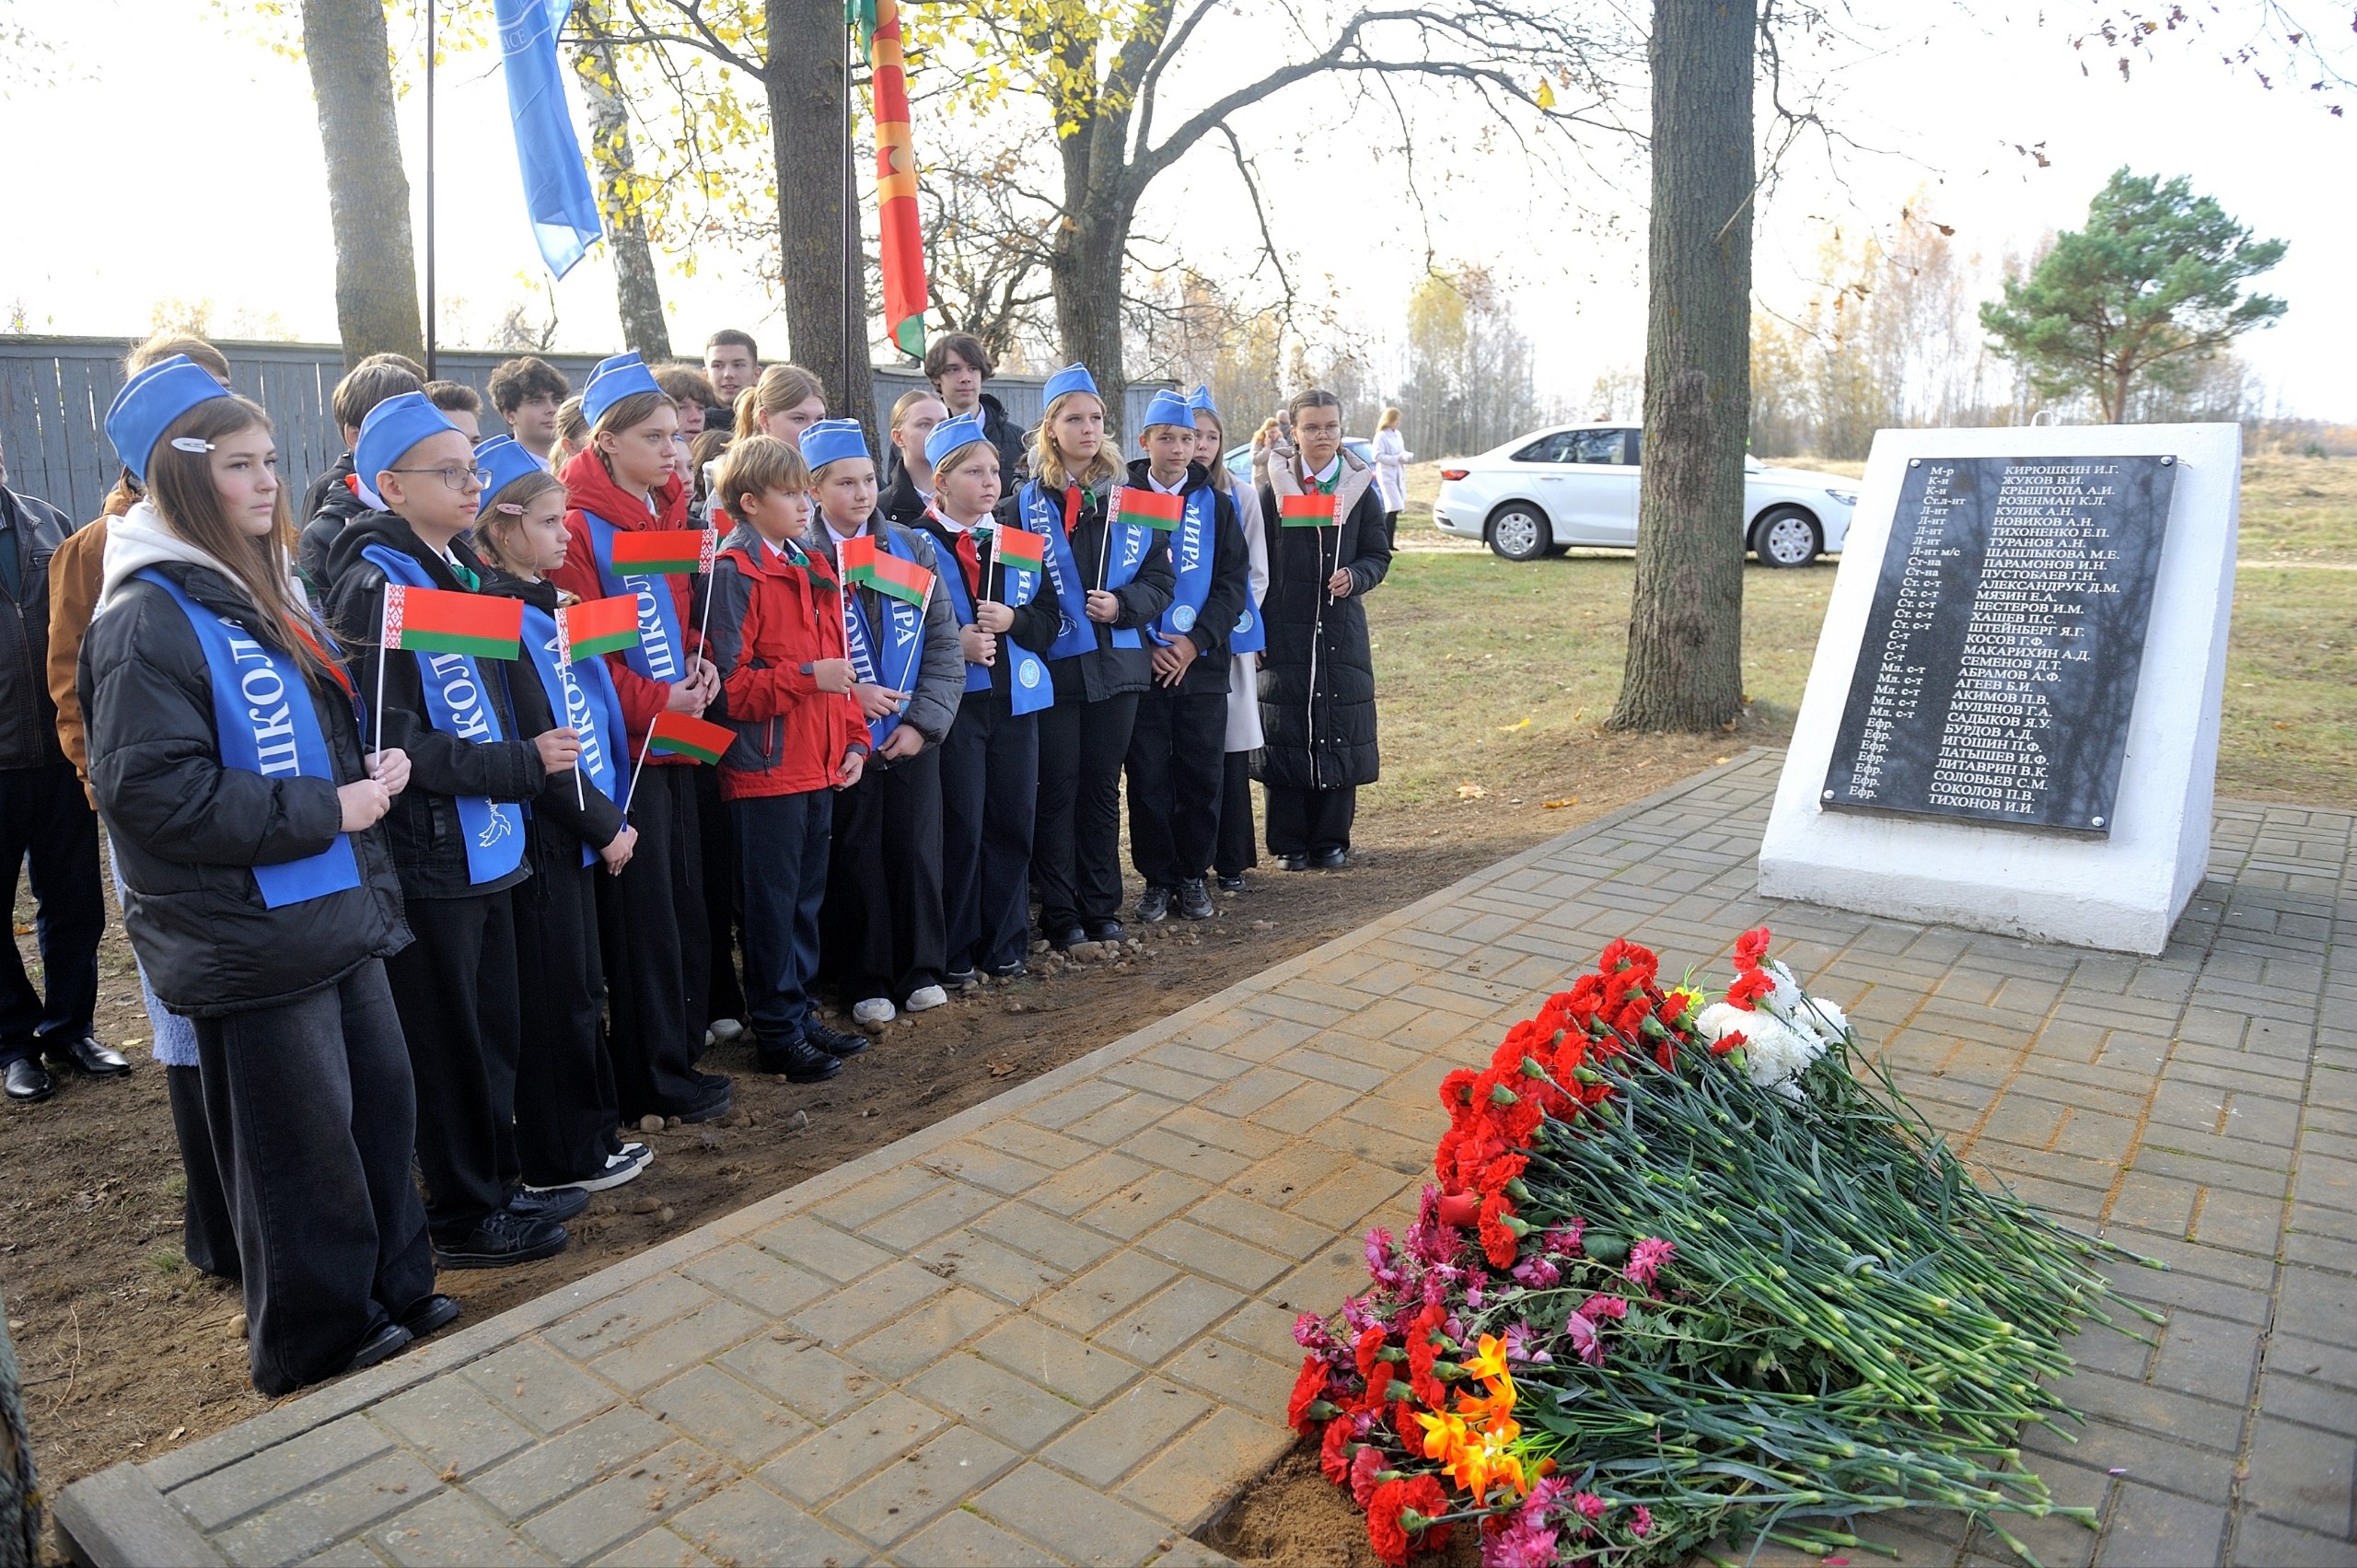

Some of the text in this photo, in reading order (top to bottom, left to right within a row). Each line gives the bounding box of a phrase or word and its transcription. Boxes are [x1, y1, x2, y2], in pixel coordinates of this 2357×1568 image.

[1930, 466, 2119, 477] М-р КИРЮШКИН И.Г.
[2003, 477, 2052, 485] ЖУКОВ
[2057, 477, 2084, 485] В.И.
[1926, 486, 2115, 495] К-н КРЫШТОПА А.И.
[1998, 497, 2075, 505] РОЗЕНМАН
[2079, 497, 2106, 505] К.Л.
[1920, 506, 2073, 516] Л-нт КУЛИК А.Н.
[1918, 517, 2095, 527] Л-нт НОВИКОВ А.Н.
[1180, 503, 1201, 574] МИРА
[1915, 527, 2109, 538] Л-нт ТИХОНЕНКО Е.П.
[1122, 524, 1143, 567] ИРА
[1912, 537, 2085, 548] Л-нт ТУРАНОВ А.Н.
[1910, 547, 2119, 559] Л-нт м/с ШАШЛЫКОВА М.Е.
[1908, 557, 2107, 570] Ст-на ПАРАМОНОВ И.Н.
[1905, 567, 2096, 581] Ст-на ПУСТОБАЕВ Г.Н.
[1014, 570, 1031, 608] ИР
[1903, 577, 1920, 587] Ст.
[1979, 580, 2085, 592] АЛЕКСАНДРУК
[2088, 584, 2119, 593] Д.М.
[1900, 588, 1917, 597] Ст.
[1976, 590, 2026, 600] МЯЗИН
[2029, 593, 2057, 602] Е.А.
[1898, 598, 1914, 607] Ст.
[1973, 601, 2049, 612] НЕСТЕРОВ
[2052, 604, 2084, 614] И.М.
[1895, 609, 1911, 618] Ст.
[2028, 614, 2056, 624] П.С.
[623, 575, 676, 680] ШКОЛ
[1892, 620, 1909, 629] Ст.
[1968, 622, 2057, 635] ШТЕЙНБЕРГ
[2060, 627, 2084, 636] Я.Г.
[844, 591, 877, 684] ШКО
[1889, 631, 2045, 646] С-т КОСОВ Г.Ф.
[1887, 641, 2091, 661] С-т МАКАРИХИН А.Д.
[1884, 652, 2061, 671] С-т СЕМЕНОВ Д.Т.
[1880, 663, 1903, 672] Мл.
[1957, 668, 2027, 679] АБРАМОВ
[2031, 671, 2061, 682] А.Ф.
[1877, 674, 1900, 683] Мл.
[1955, 679, 2003, 690] АГЕЕВ
[2006, 681, 2033, 691] Б.И.
[217, 616, 300, 776] ШКОЛ
[428, 653, 493, 744] КОЛ
[1875, 685, 2049, 704] Мл. с-т АКИМОВ П.В.
[1872, 696, 1895, 705] Мл.
[1898, 699, 1918, 707] с-т
[2026, 706, 2052, 716] Г.А.
[1869, 706, 2050, 728] Мл. с-т САДЫКОВ Я.У.
[1866, 717, 2033, 740] Ефр. БУРДОВ А.Д.
[1864, 729, 2042, 752] Ефр. ИГОШИН П.Ф.
[1861, 740, 2049, 765] Ефр. ЛАТЫШЕВ И.Ф.
[1858, 751, 2049, 777] Ефр. ЛИТАВРИН В.К.
[1854, 762, 2048, 790] Ефр. СОЛОВЬЕВ С.М.
[1852, 774, 2035, 801] Ефр. СОКОЛОВ П.В.
[1849, 785, 2035, 814] Ефр. ТИХОНОВ И.И.
